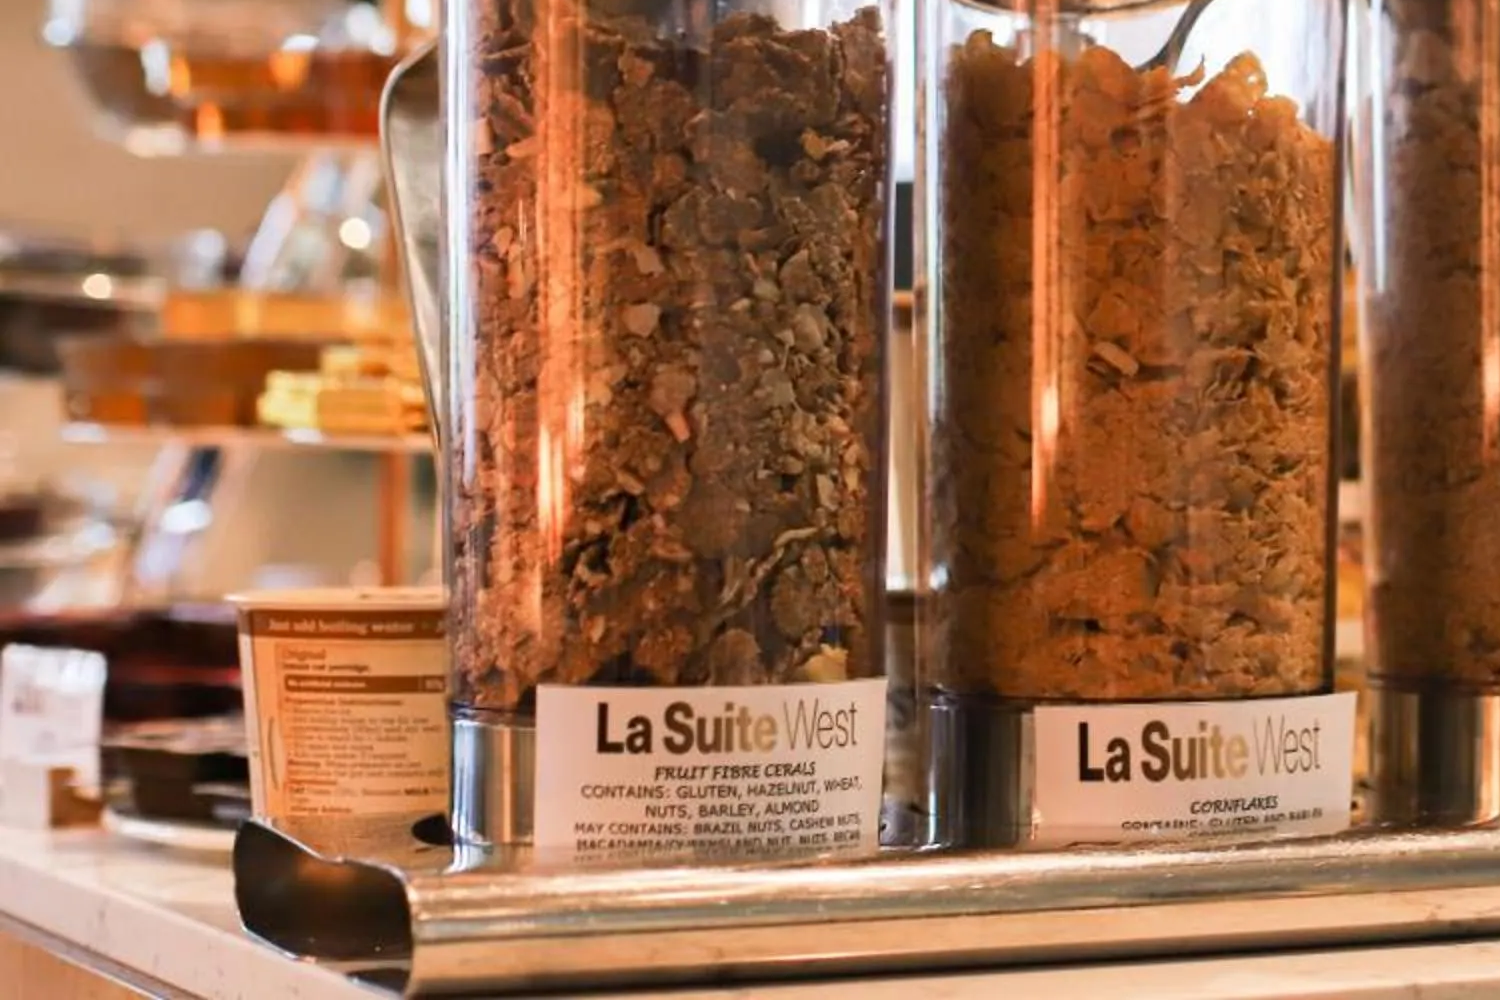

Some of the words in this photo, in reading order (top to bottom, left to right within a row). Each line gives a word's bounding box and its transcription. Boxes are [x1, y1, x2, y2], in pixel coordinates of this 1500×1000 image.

[597, 702, 652, 753] La
[663, 701, 778, 754] Suite
[783, 698, 858, 750] West
[1079, 721, 1131, 782] La
[1141, 720, 1249, 783] Suite
[1253, 714, 1321, 775] West
[655, 765, 709, 781] FRUIT
[712, 763, 760, 780] FIBRE
[763, 761, 817, 778] CERALS
[580, 784, 671, 799] CONTAINS:
[676, 783, 743, 800] GLUTEN,
[747, 779, 821, 796] HAZELNUT,
[645, 804, 693, 820] NUTS,
[698, 803, 761, 818] BARLEY,
[765, 799, 820, 815] ALMOND
[1189, 794, 1279, 814] CORNFLAKES
[574, 822, 604, 834] MAY
[608, 822, 688, 835] CONTAINS:
[693, 821, 742, 834] BRAZIL
[789, 815, 835, 830] CASHEW
